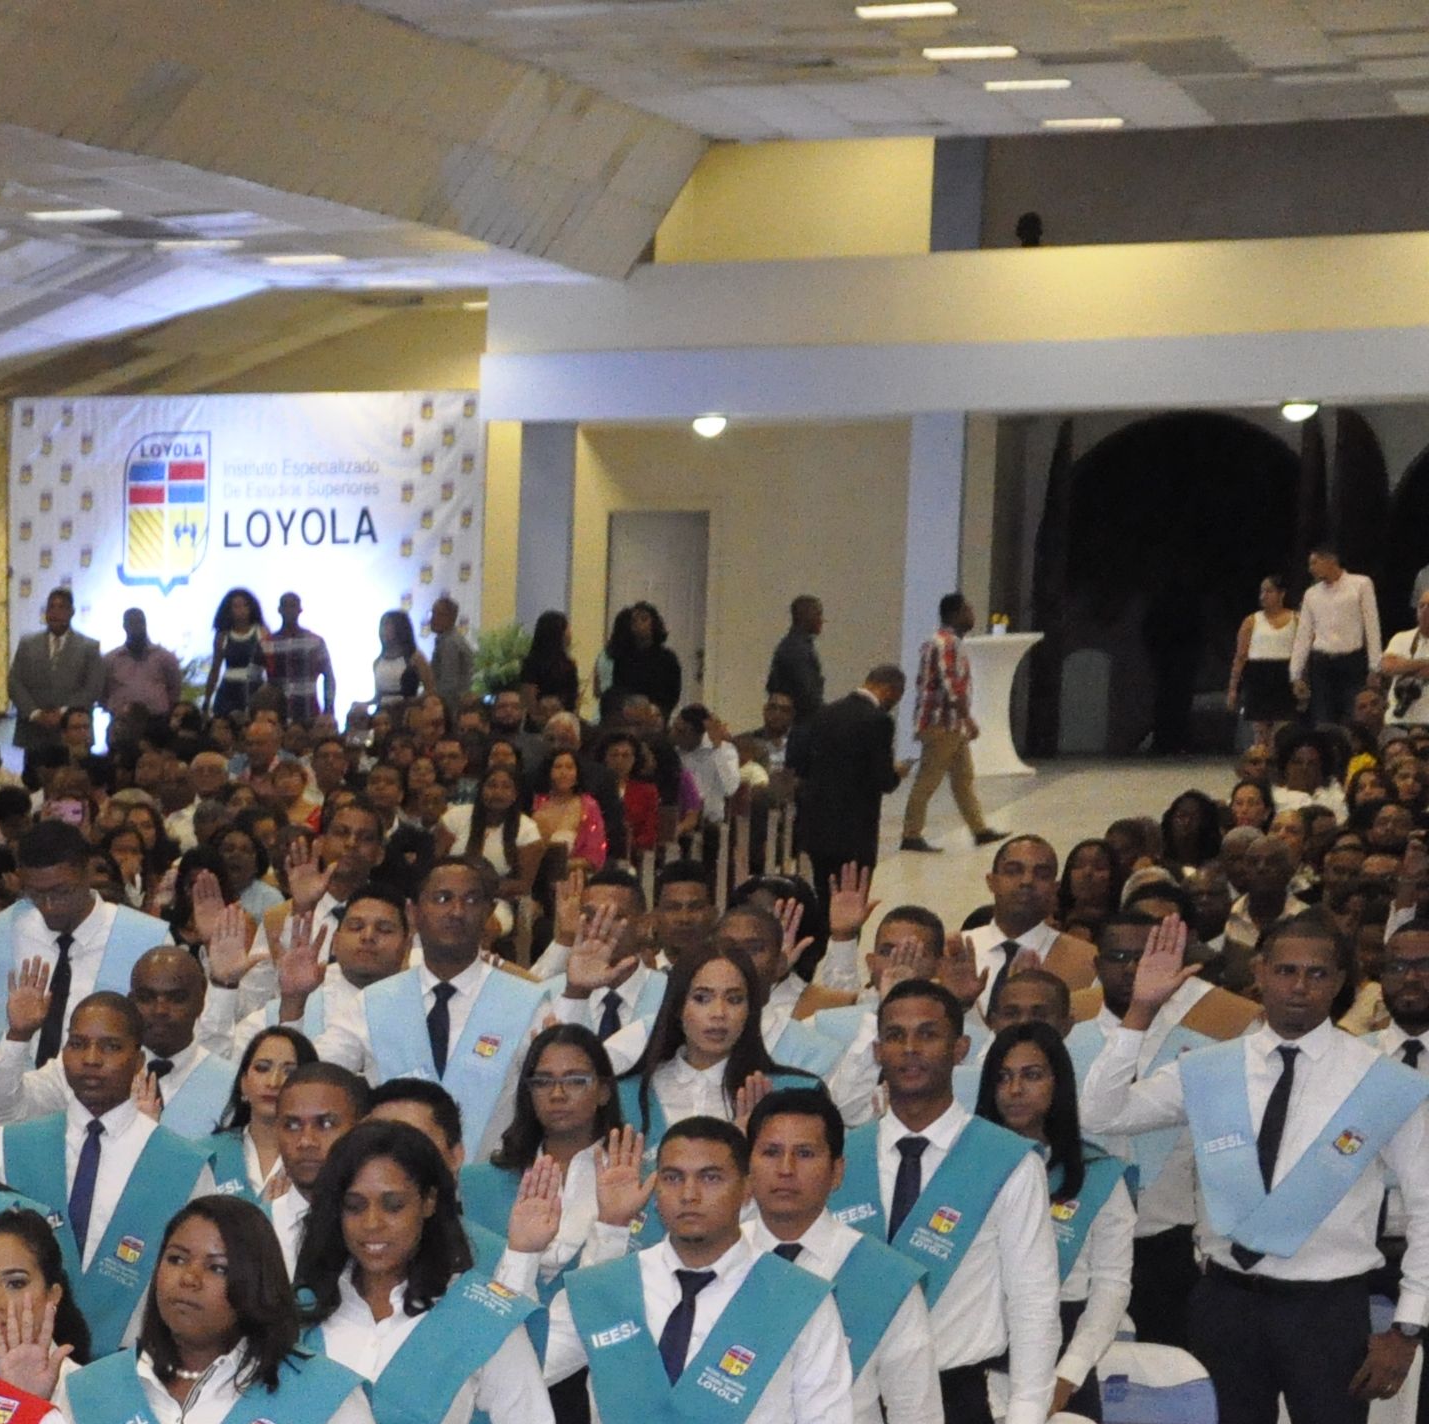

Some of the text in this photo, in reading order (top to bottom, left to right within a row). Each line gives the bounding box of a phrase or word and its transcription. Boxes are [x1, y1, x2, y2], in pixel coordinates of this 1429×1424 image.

[141, 443, 203, 458] LOYOLA
[282, 459, 380, 477] Especializado
[307, 480, 380, 497] Superiores
[223, 506, 379, 548] LOYOLA
[591, 1320, 641, 1348] IEESL
[697, 1376, 741, 1404] LOYOLA
